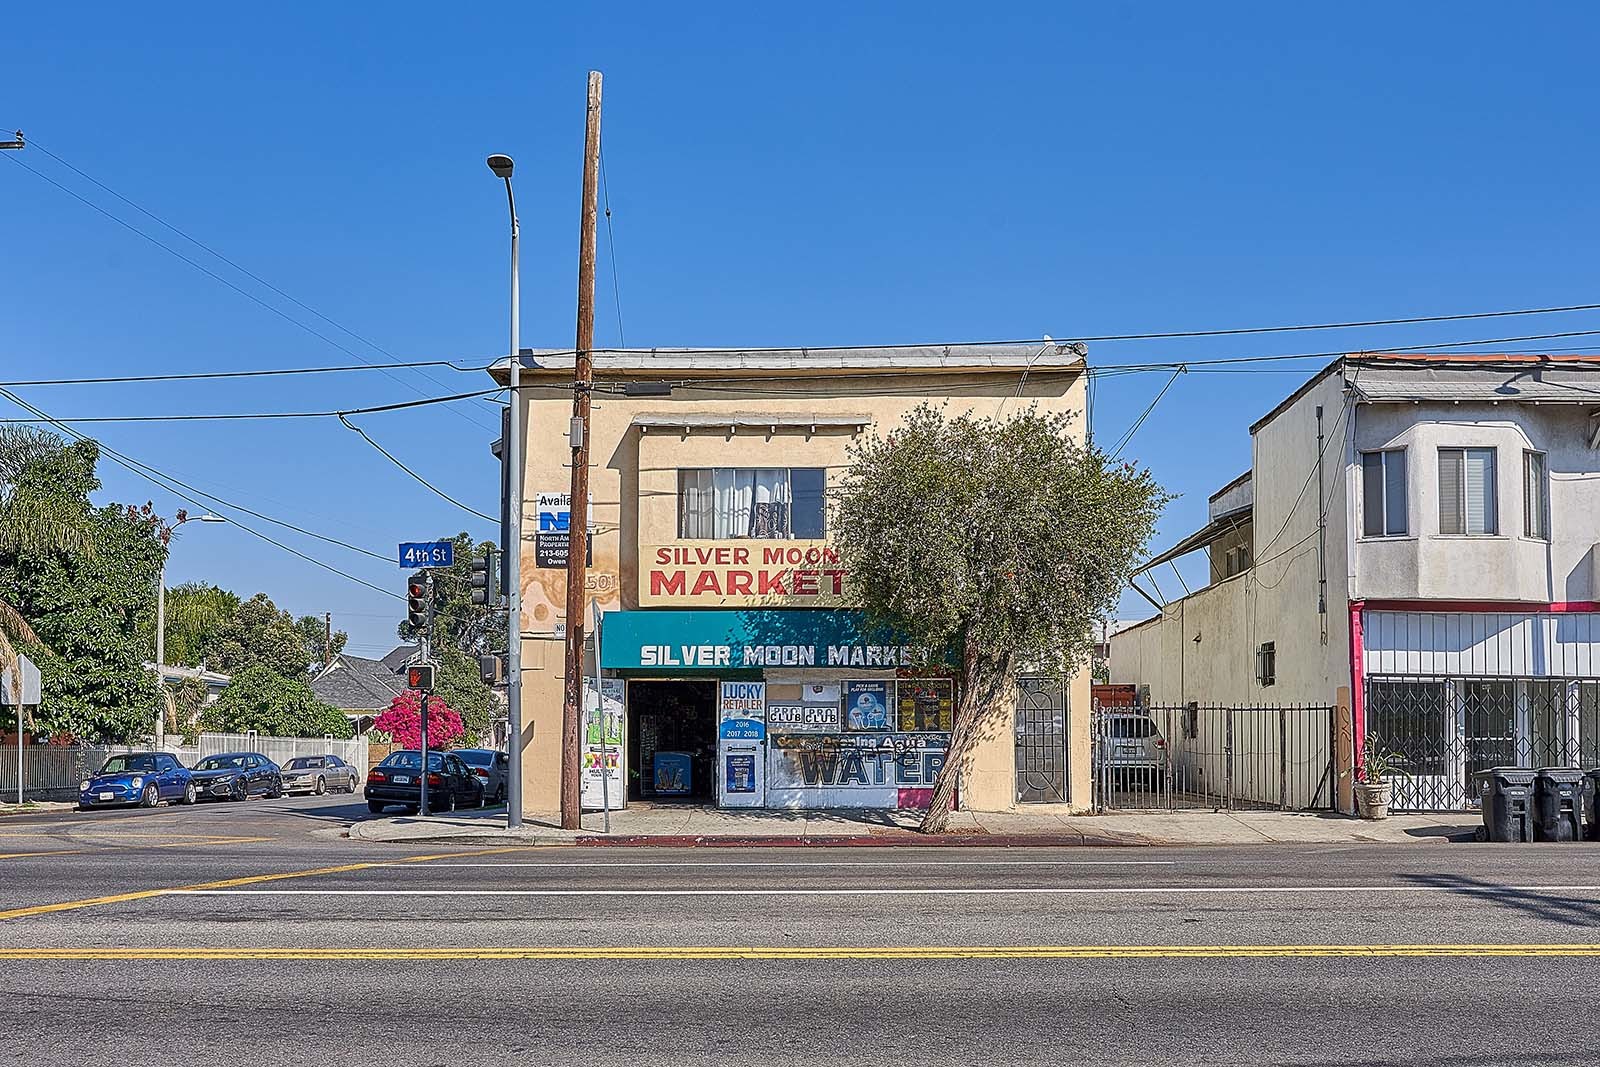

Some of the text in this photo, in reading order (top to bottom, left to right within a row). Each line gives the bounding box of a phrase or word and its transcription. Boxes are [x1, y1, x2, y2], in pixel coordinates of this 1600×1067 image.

[540, 495, 571, 506] Availa
[405, 548, 446, 562] 4th St
[656, 548, 840, 565] SILVER MOON
[650, 570, 848, 596] MARKET
[641, 645, 730, 666] SILVER
[743, 645, 815, 666] MOON
[723, 684, 763, 699] LUCKY
[723, 700, 763, 710] RETAILER
[770, 713, 801, 721] CLUB
[774, 707, 797, 716] PRO
[809, 708, 833, 717] PRO
[805, 714, 836, 723] CLUB
[800, 751, 948, 786] WATER
